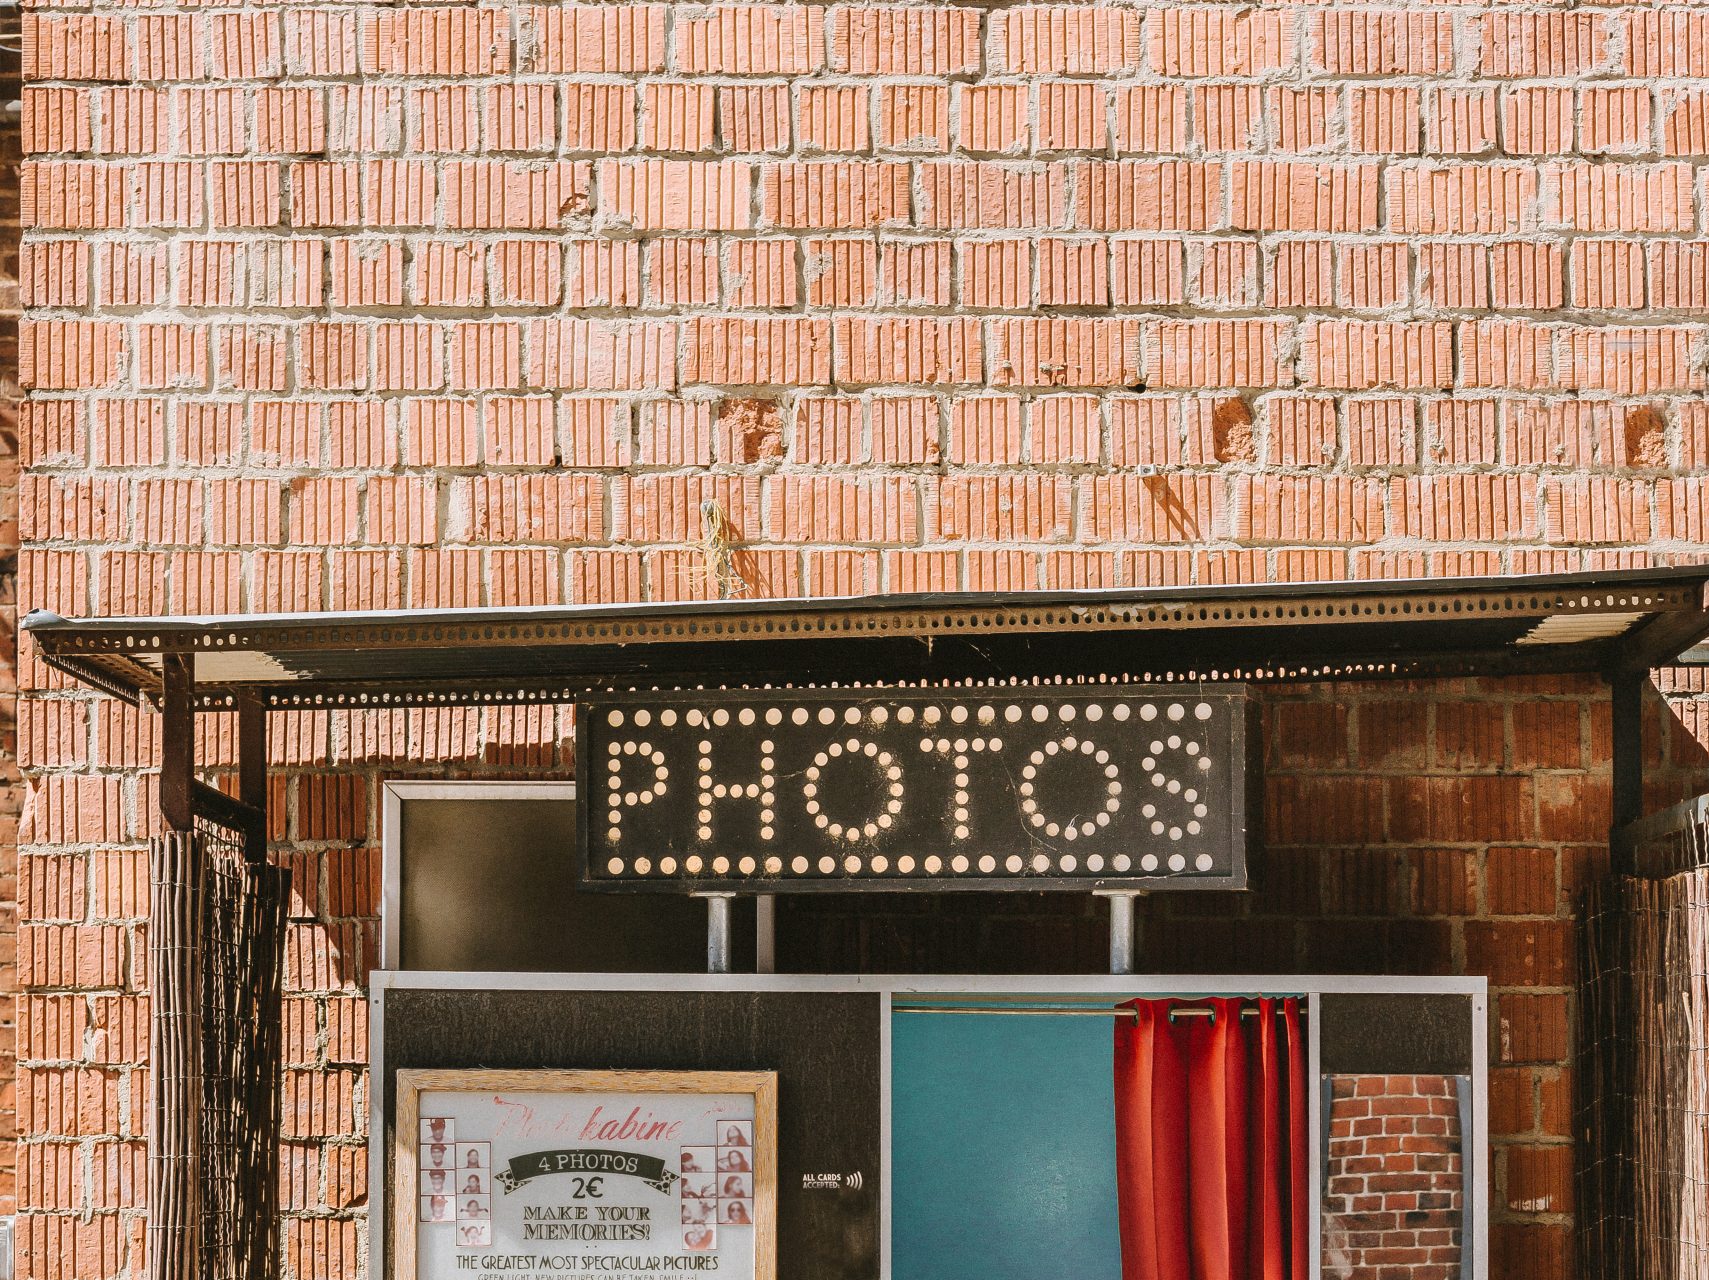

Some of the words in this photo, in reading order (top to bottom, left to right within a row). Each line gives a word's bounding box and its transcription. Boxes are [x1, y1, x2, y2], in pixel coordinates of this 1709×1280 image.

[607, 734, 1212, 841] PHOTOS
[538, 1156, 551, 1171] 4
[555, 1153, 639, 1172] PHOTOS
[802, 1173, 816, 1182] ALL
[817, 1173, 842, 1182] CARDS
[571, 1176, 604, 1199] 2€
[523, 1206, 588, 1221] MAKE
[594, 1206, 651, 1221] YOUR
[456, 1255, 478, 1270] THE
[481, 1255, 537, 1270] GREATEST
[539, 1255, 578, 1270] MOST
[580, 1255, 661, 1271] SPECTACULAR
[663, 1255, 719, 1271] PICTURES
